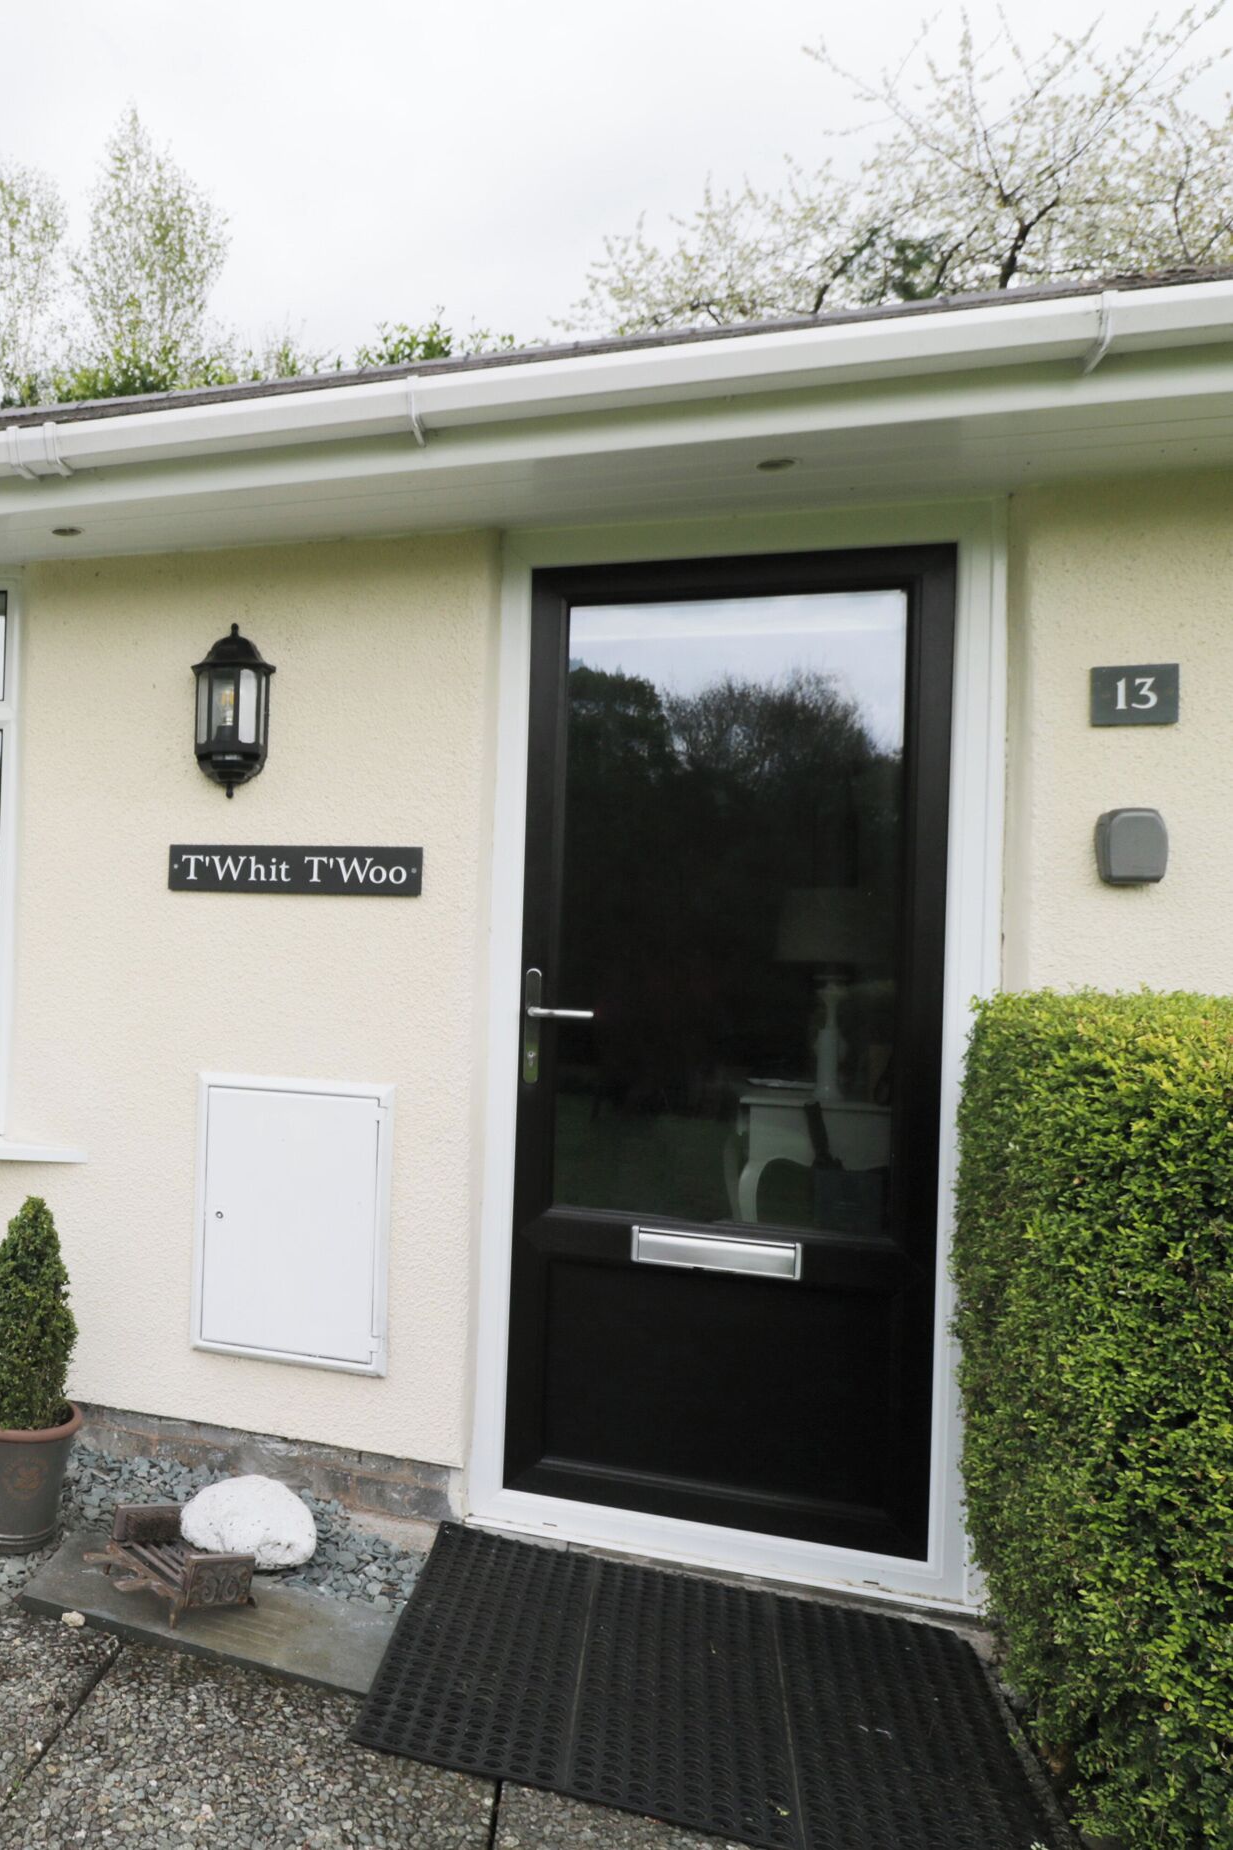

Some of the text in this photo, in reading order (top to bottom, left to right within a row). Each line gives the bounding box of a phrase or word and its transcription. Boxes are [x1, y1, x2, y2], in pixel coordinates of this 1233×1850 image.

[1115, 676, 1158, 710] 13
[181, 854, 407, 884] T'Whit T'Woo
